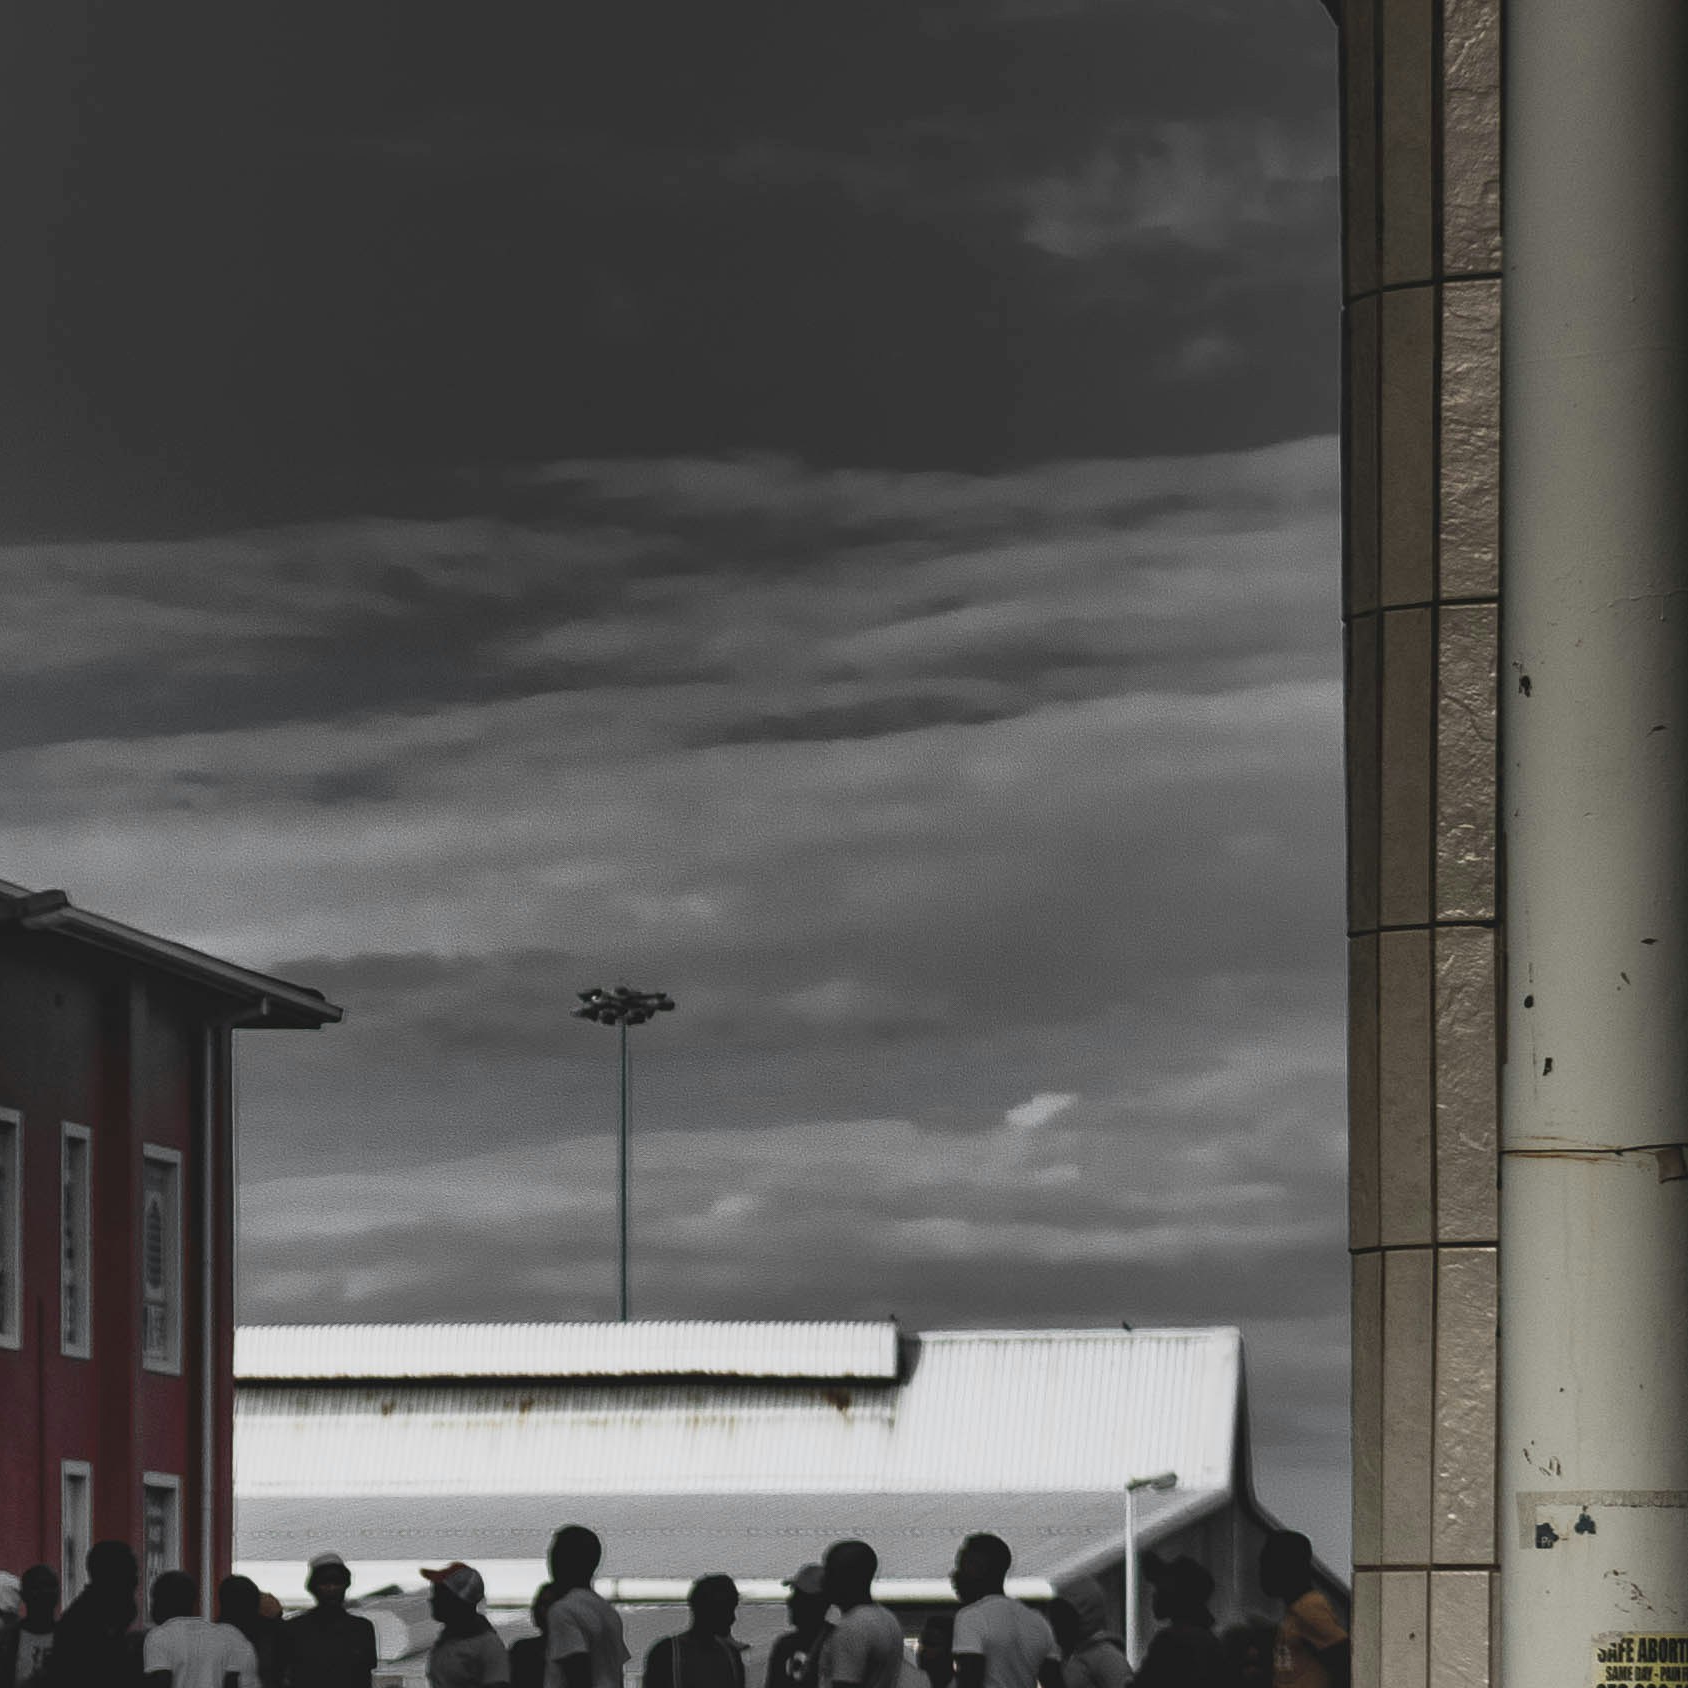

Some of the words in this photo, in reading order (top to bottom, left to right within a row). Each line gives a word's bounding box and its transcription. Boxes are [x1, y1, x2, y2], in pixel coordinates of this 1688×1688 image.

[1606, 1666, 1633, 1681] SAME
[1635, 1666, 1653, 1681] DAY
[1660, 1666, 1681, 1681] PAIN
